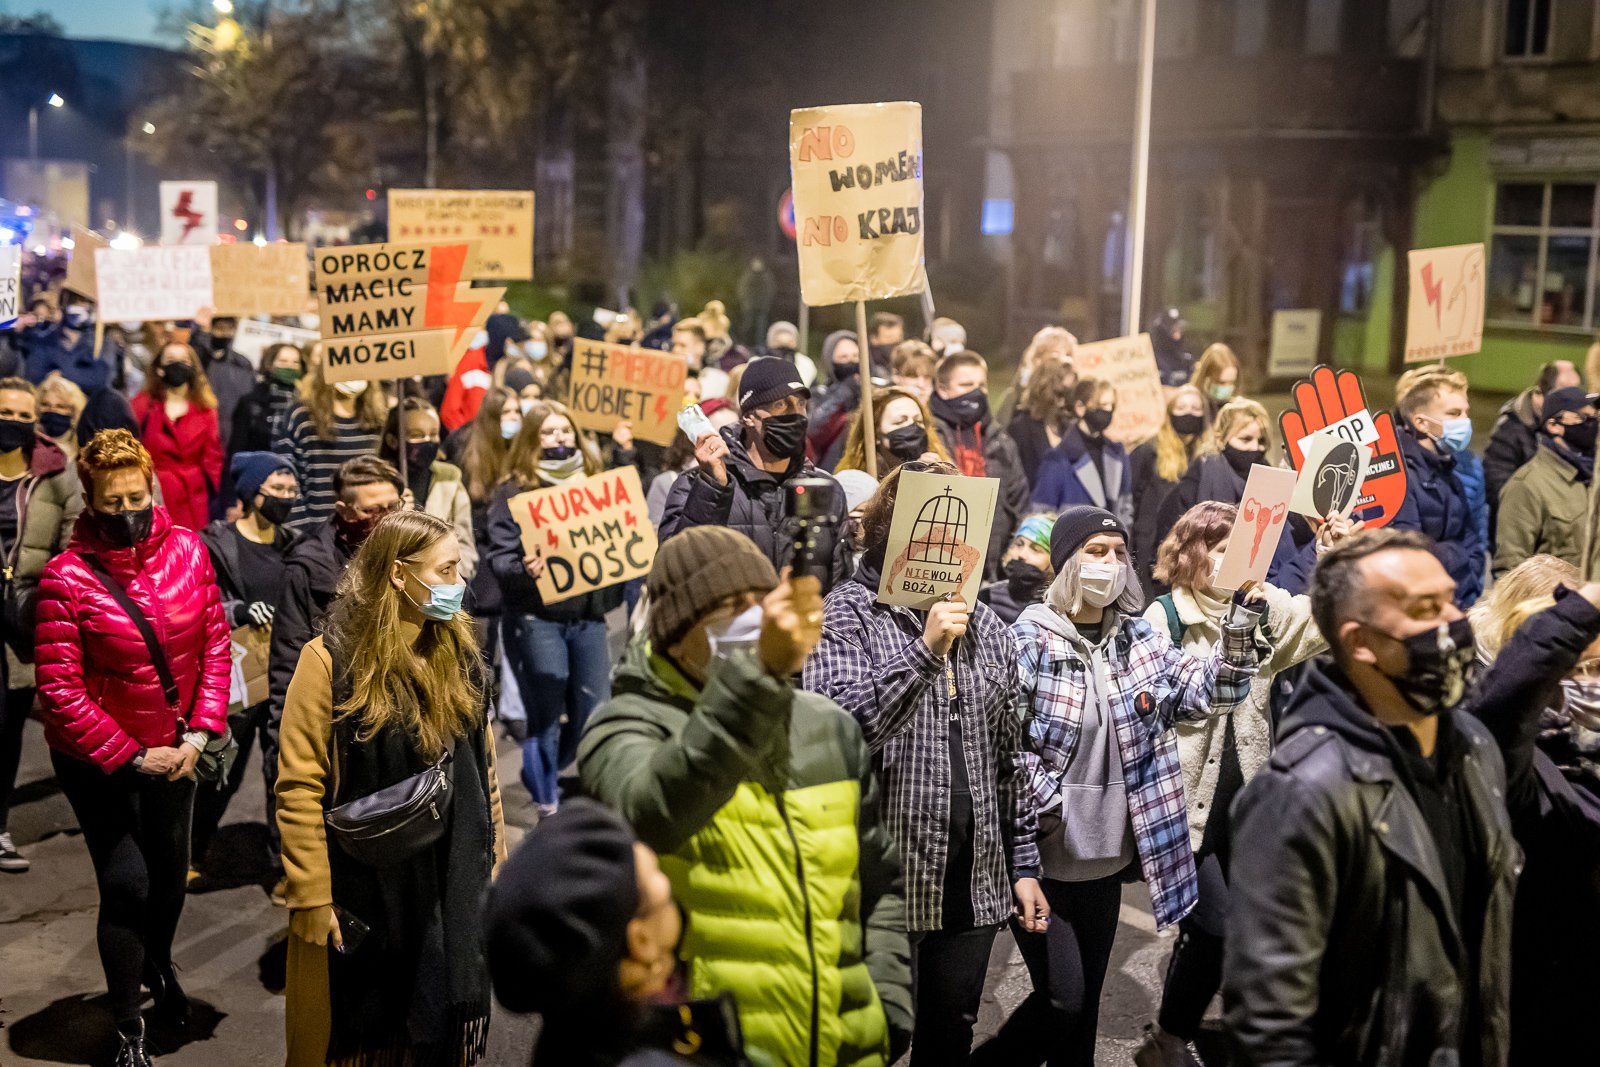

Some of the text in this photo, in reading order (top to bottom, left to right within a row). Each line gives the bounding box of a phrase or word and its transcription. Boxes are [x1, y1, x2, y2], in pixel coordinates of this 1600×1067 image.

[799, 125, 855, 162] NO
[803, 207, 920, 247] NO KRAJ
[321, 245, 427, 274] OPRÓCZ
[326, 278, 413, 304] MACIC
[332, 307, 416, 334] MAMY
[328, 339, 416, 367] MÓZGI
[572, 382, 652, 421] KOBIET
[527, 476, 631, 529] KURWA
[568, 518, 623, 549] MAM
[546, 530, 649, 594] DOŚĆ
[905, 567, 963, 582] NIEWOLA
[902, 580, 936, 595] BOŻA
